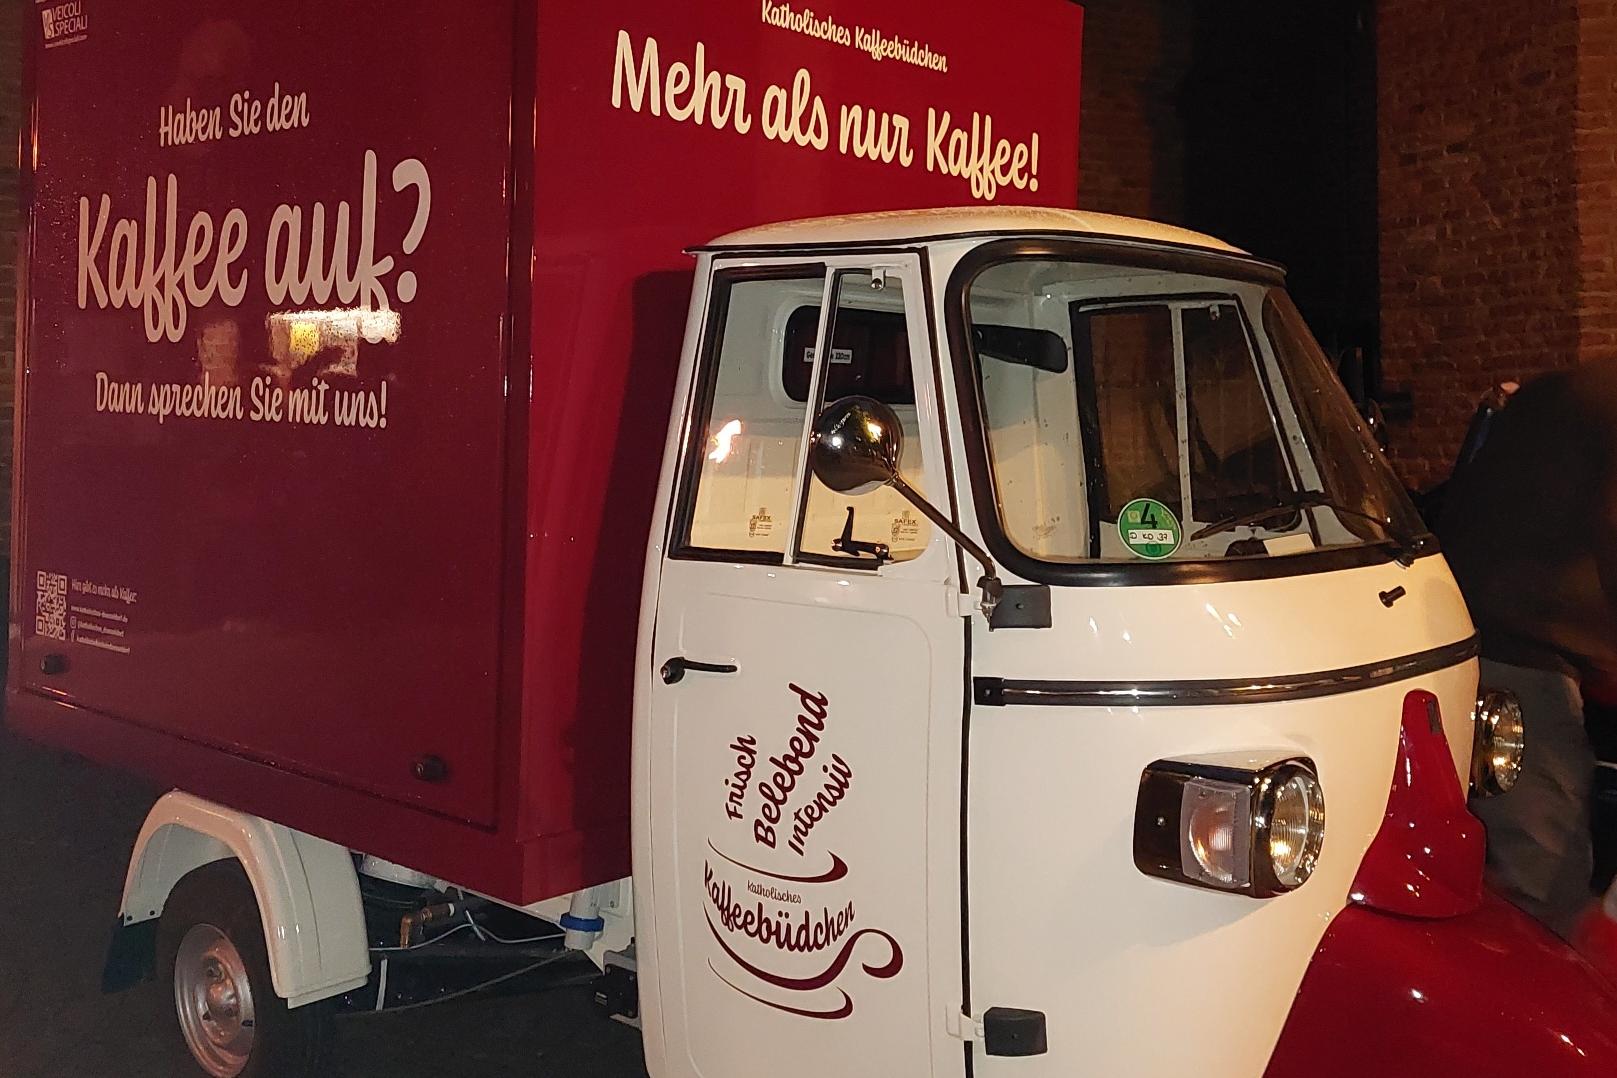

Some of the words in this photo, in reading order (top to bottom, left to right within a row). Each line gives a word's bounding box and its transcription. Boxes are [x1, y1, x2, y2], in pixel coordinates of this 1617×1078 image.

[52, 1, 81, 20] VEICOLI
[55, 15, 87, 36] SPECIALI
[762, 0, 851, 47] Katholisches
[855, 25, 948, 73] Kaffeebüdchen
[159, 97, 223, 147] Haben
[228, 90, 262, 138] Sie
[266, 82, 310, 132] den
[611, 29, 752, 135] Mehr
[761, 68, 829, 151] als
[839, 104, 914, 168] nur
[926, 107, 1039, 201] Kaffee!
[77, 173, 248, 343] Kaffee
[264, 149, 431, 343] auf?
[95, 371, 145, 414] Dann
[147, 372, 244, 424] sprechen
[249, 376, 283, 423] Sie
[288, 377, 330, 425] mit
[334, 380, 387, 429] uns!
[1141, 503, 1158, 529] 4
[724, 734, 758, 820] Frisch
[753, 682, 829, 849] Belebend
[787, 753, 853, 857] Intensiv
[704, 859, 855, 953] Kaffeebüdchen
